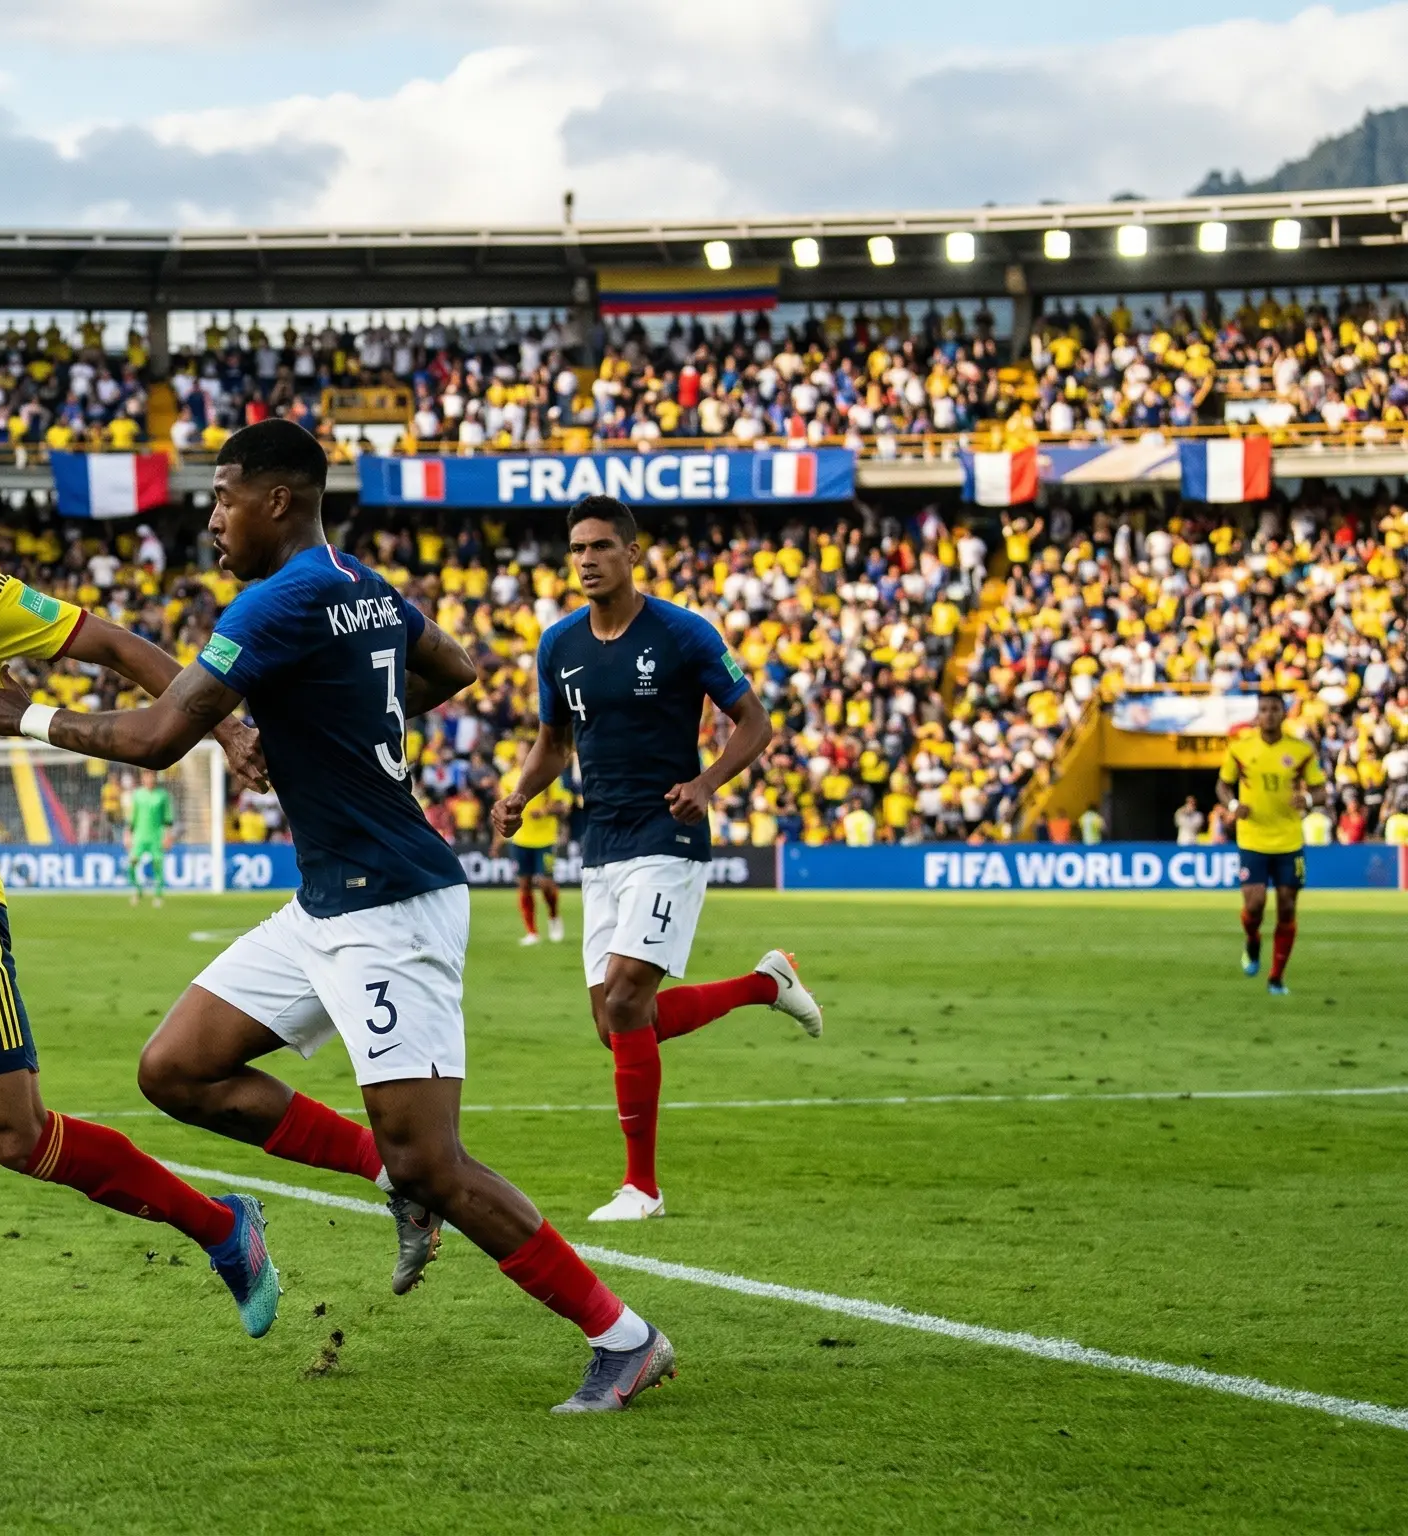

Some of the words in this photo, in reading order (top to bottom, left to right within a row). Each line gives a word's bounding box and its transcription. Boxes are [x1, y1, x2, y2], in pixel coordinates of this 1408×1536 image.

[497, 454, 730, 502] FRANCE!
[371, 648, 409, 782] 3
[565, 683, 586, 721] 4
[923, 851, 1012, 888] FIFA
[1015, 851, 1163, 888] WORLD
[1167, 851, 1241, 888] CUP
[652, 892, 672, 933] 4
[366, 981, 397, 1035] 3
